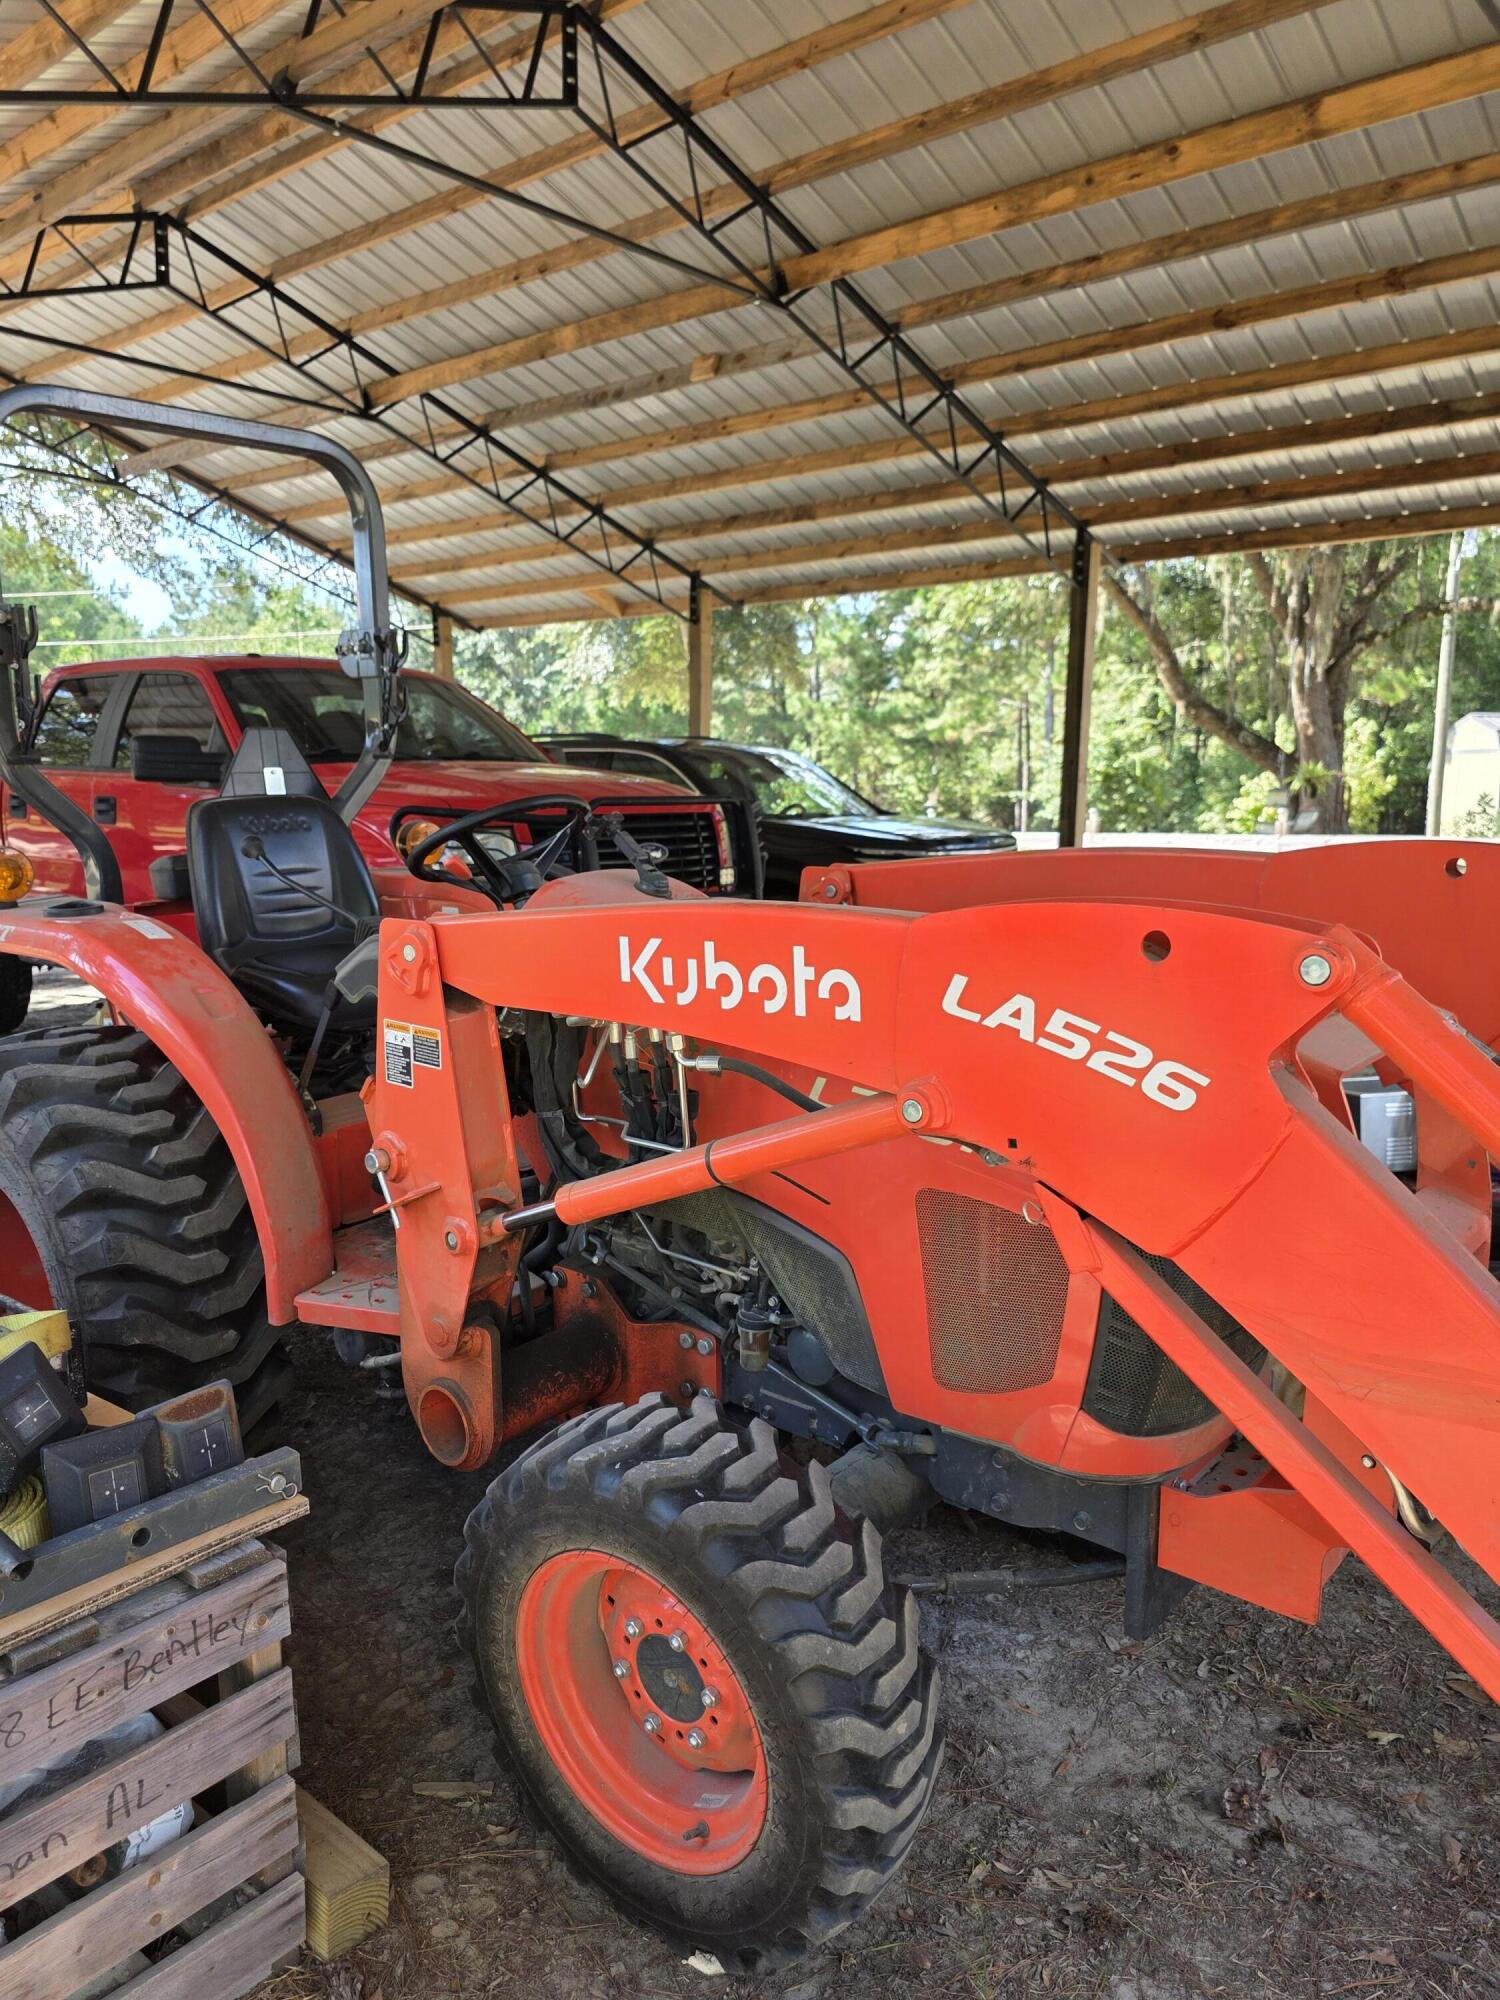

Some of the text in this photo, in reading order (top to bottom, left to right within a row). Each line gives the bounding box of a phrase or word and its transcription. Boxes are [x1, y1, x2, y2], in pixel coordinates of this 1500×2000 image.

[618, 936, 862, 1023] Kubota
[941, 973, 1212, 1112] LA526
[0, 1711, 26, 1748] 8
[122, 1602, 255, 1690] Bentley
